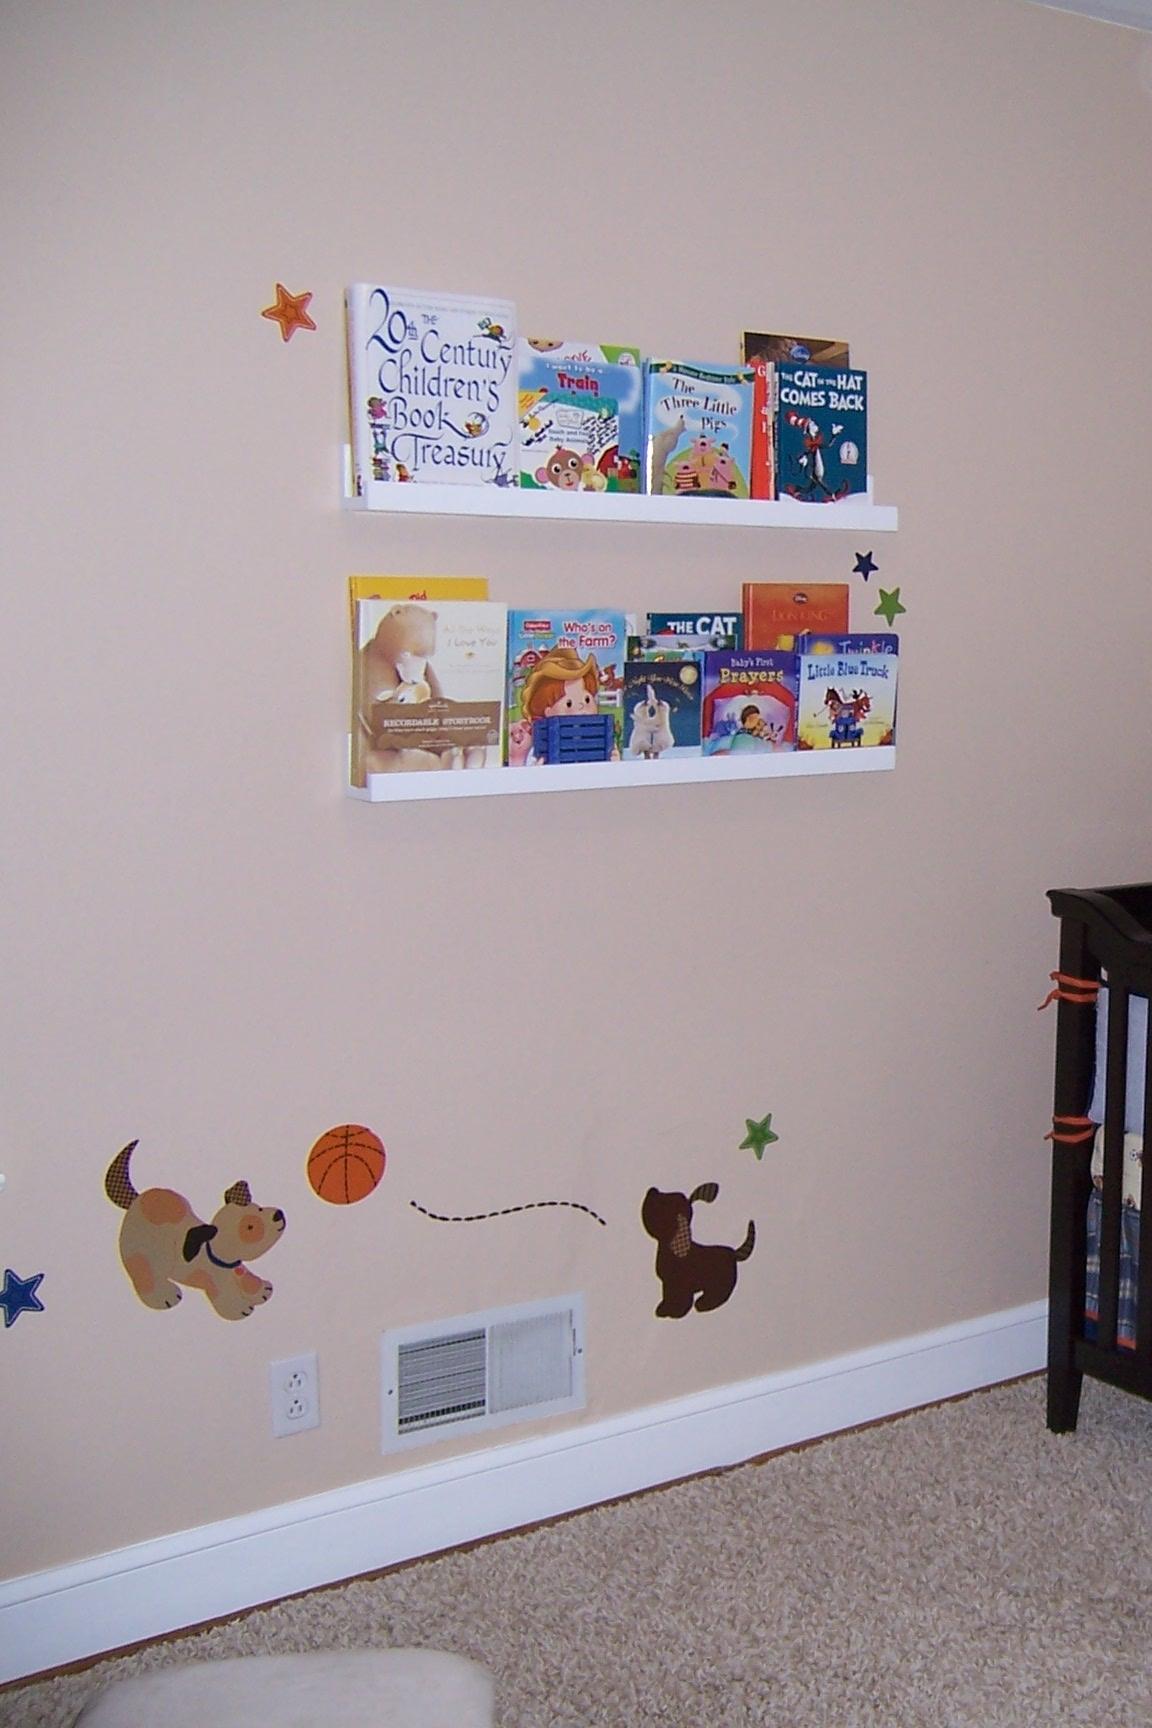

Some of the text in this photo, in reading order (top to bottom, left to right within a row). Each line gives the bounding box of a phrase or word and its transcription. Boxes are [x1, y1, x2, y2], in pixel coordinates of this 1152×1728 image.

[365, 288, 419, 354] 20th
[420, 329, 515, 385] Century
[378, 348, 500, 413] Children's
[557, 373, 599, 396] Train
[672, 376, 695, 395] The
[781, 372, 794, 382] THE
[793, 370, 819, 389] CAT
[837, 374, 863, 391] HAT
[660, 395, 737, 416] Three Little
[780, 387, 864, 412] COMES BACK
[386, 396, 480, 439] Book
[701, 417, 727, 434] Pigs
[391, 428, 514, 472] Treasury
[563, 622, 595, 633] Who's
[667, 616, 737, 636] THE CAT
[558, 635, 616, 648] the Farm?
[730, 657, 774, 669] Baby's First
[807, 660, 889, 681] Little Blue Truck
[720, 667, 784, 686] Prayers
